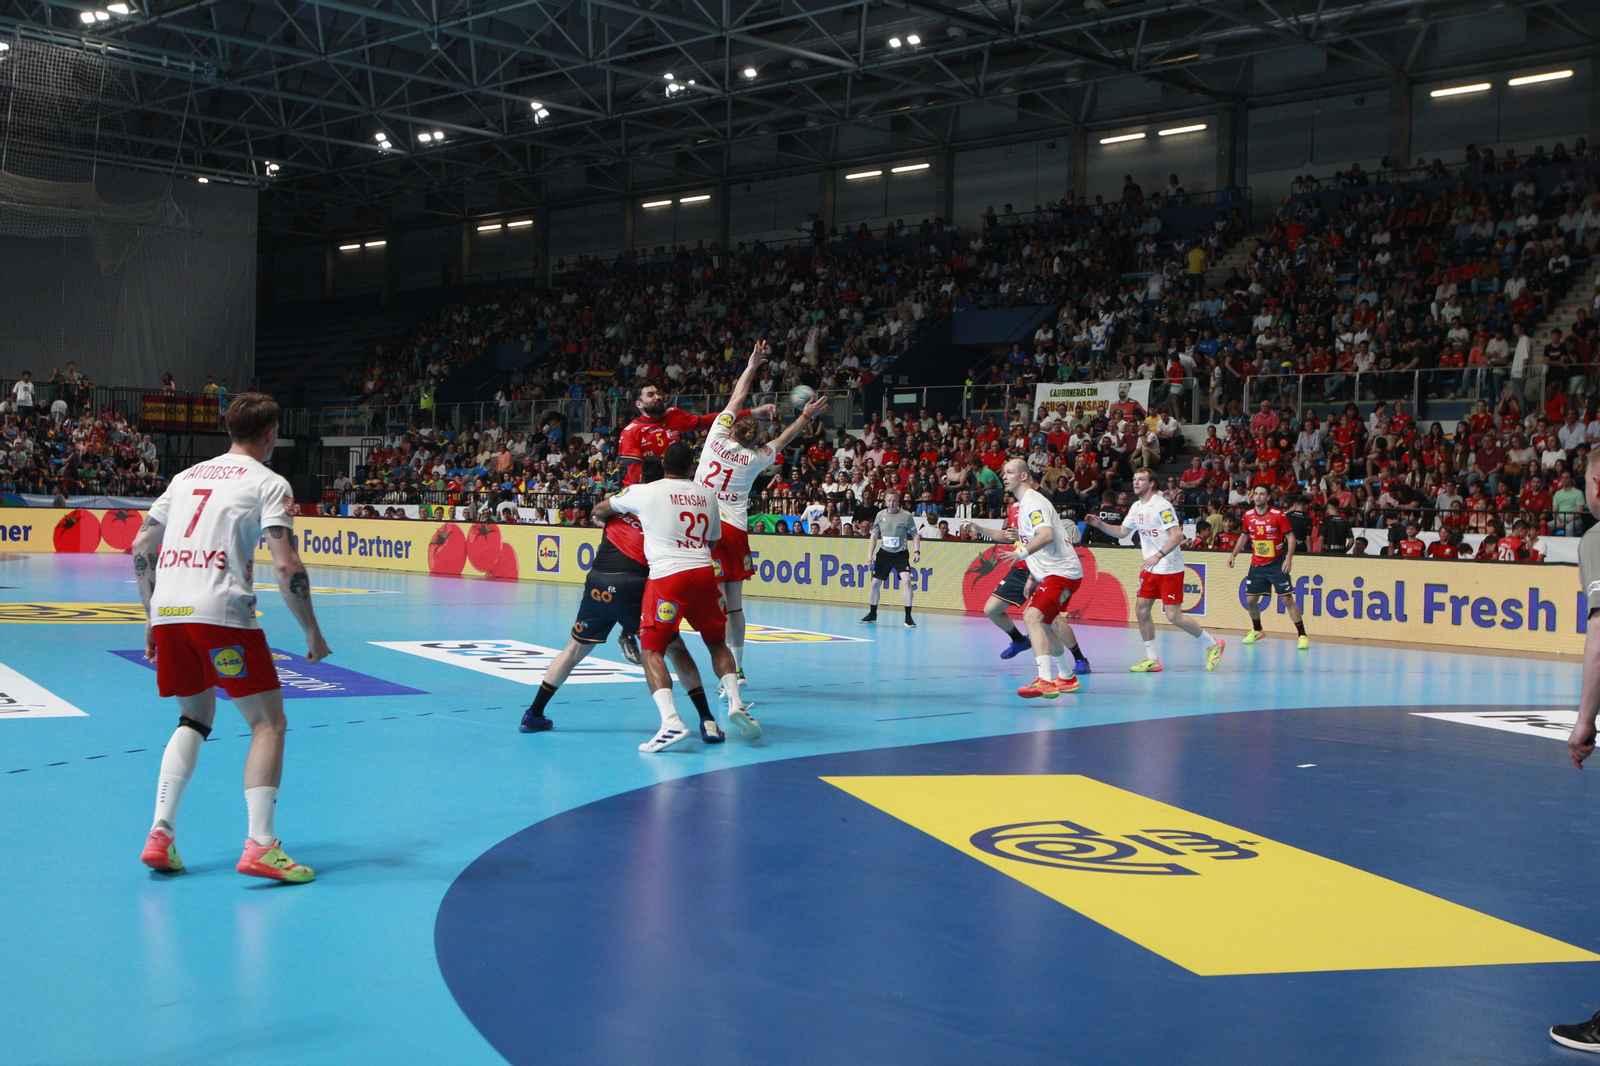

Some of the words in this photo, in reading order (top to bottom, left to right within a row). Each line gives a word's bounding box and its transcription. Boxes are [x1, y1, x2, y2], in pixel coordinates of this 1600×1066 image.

[1050, 388, 1086, 398] CARBONERAS
[1087, 387, 1099, 396] CON
[655, 432, 664, 447] 5
[703, 460, 734, 492] 21
[669, 493, 708, 508] MENSAH
[714, 491, 739, 502] LYS
[183, 488, 214, 538] 7
[679, 511, 709, 544] 22
[304, 529, 343, 555] Food
[347, 531, 411, 559] Partner
[590, 588, 613, 603] GO
[607, 585, 617, 594] fit
[157, 606, 195, 617] BORUP
[1238, 574, 1408, 623] Oficial
[1423, 583, 1557, 633] Fresh
